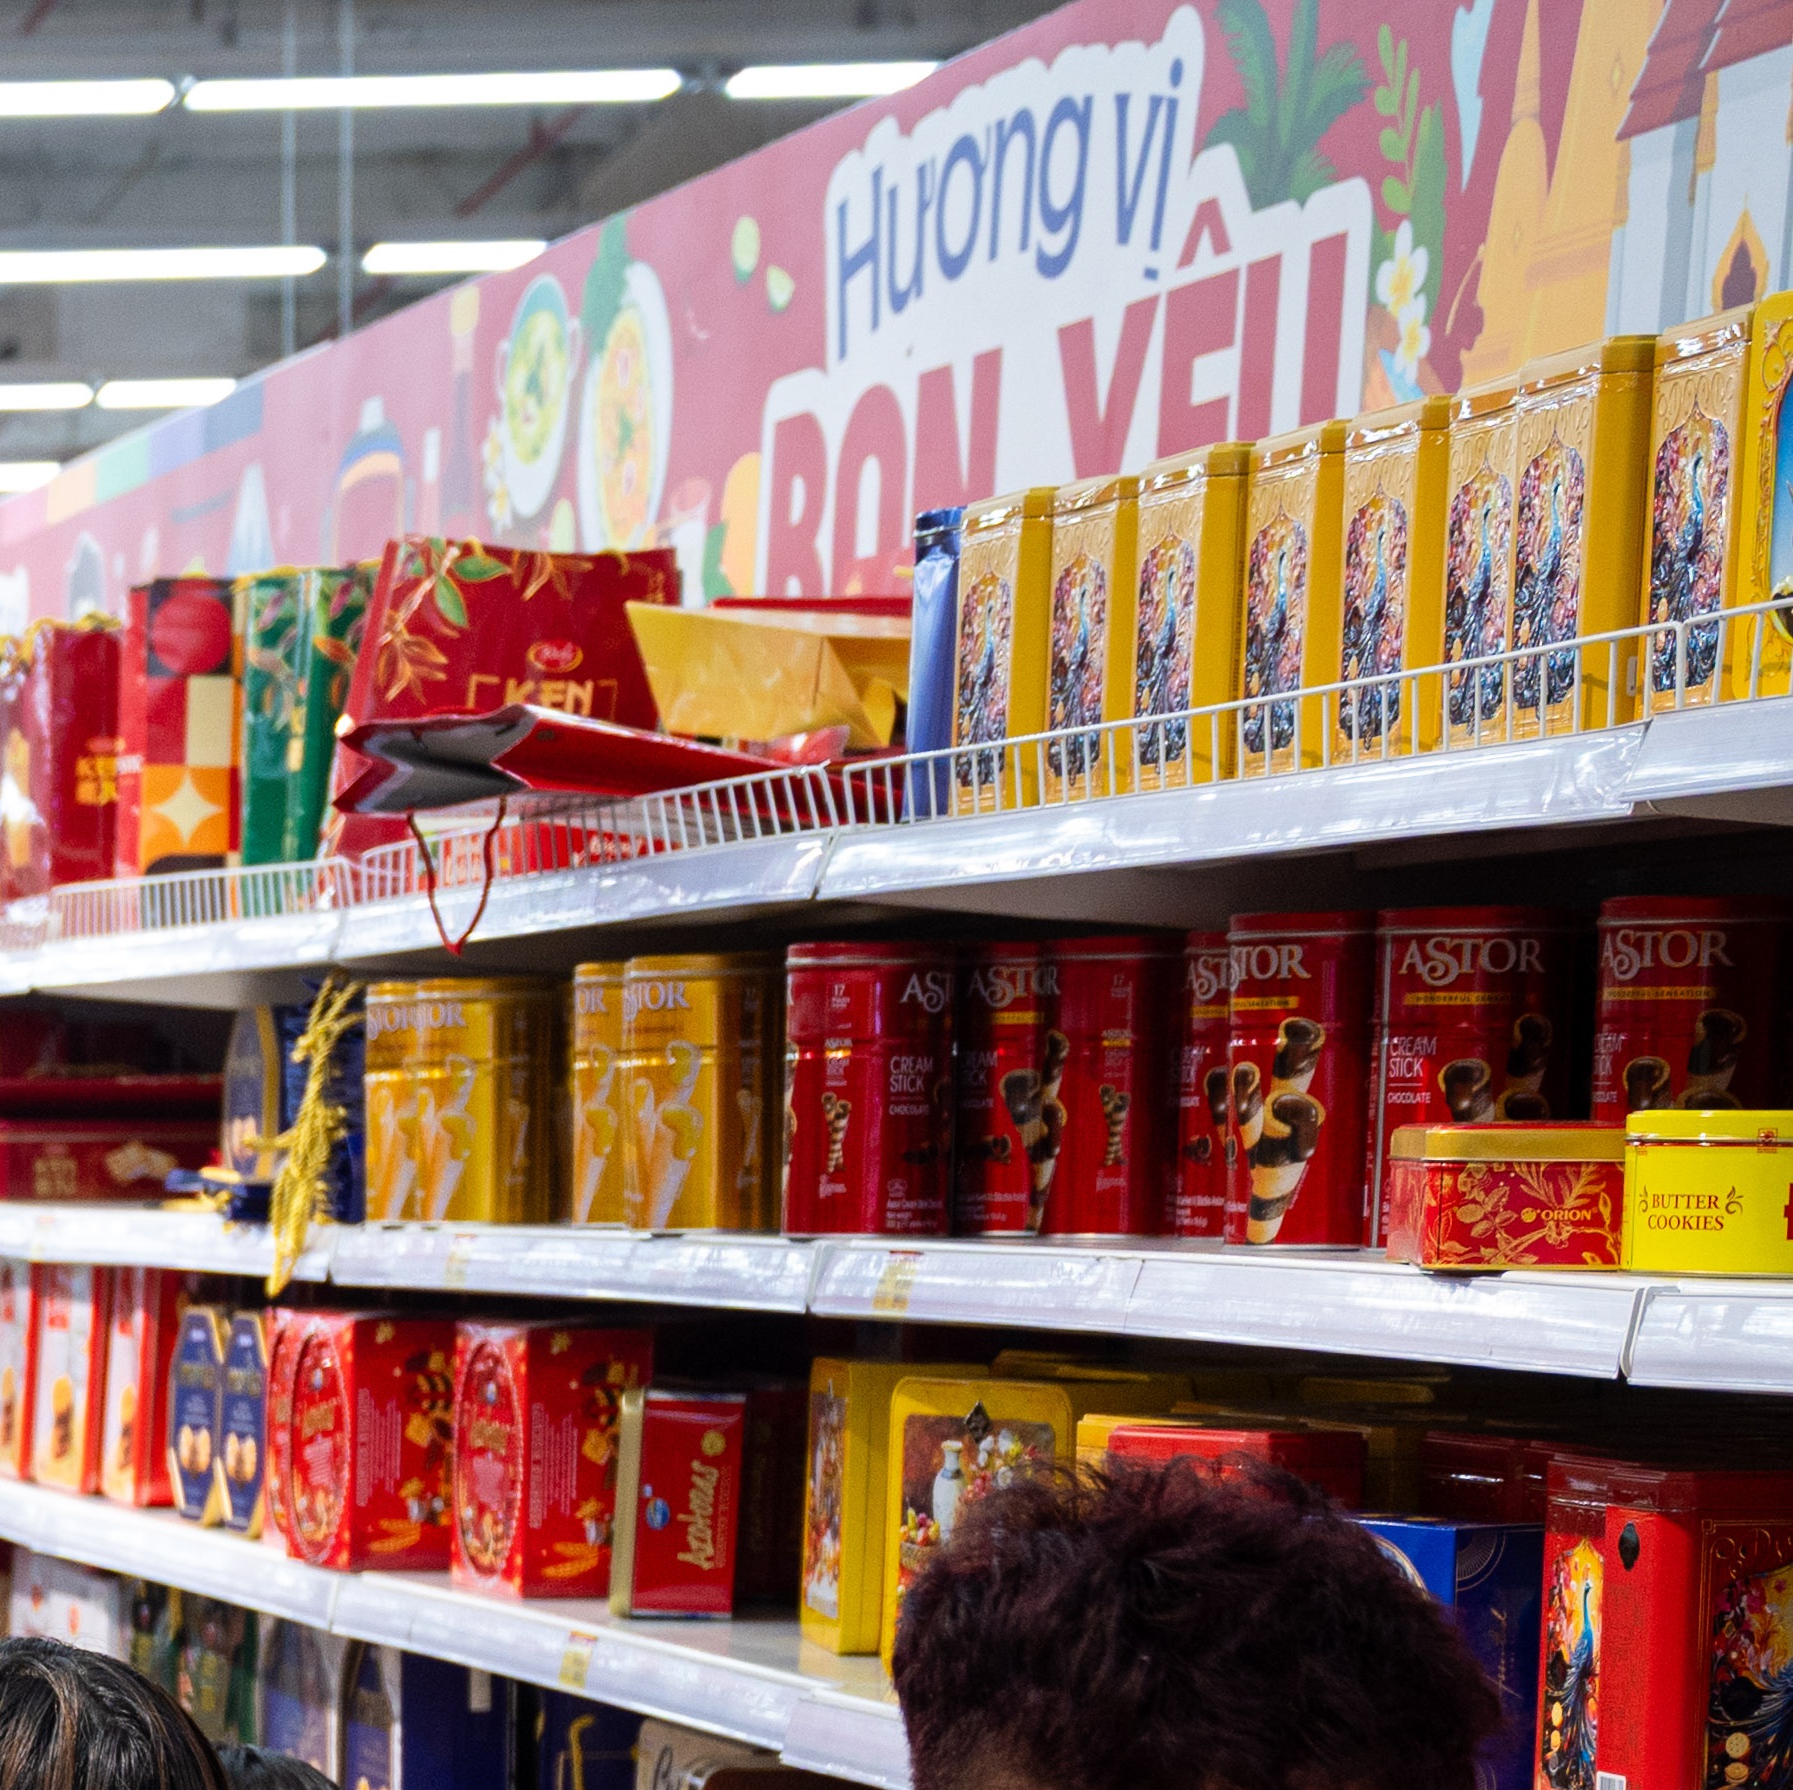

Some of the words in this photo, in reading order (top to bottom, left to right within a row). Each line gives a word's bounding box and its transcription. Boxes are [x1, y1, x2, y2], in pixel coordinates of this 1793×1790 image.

[837, 91, 1094, 361] Hương
[1114, 57, 1186, 280] vị
[1059, 198, 1350, 477] YÊU
[1399, 937, 1544, 986] ASTOR
[1601, 929, 1735, 981] ASTOR
[900, 971, 953, 1013] AST
[1389, 1036, 1437, 1056] CREAM
[890, 1056, 933, 1074] CREAM
[1389, 1058, 1424, 1078] STICK
[890, 1075, 925, 1093] STICK
[1387, 1091, 1431, 1104] CHOCOLATE
[1652, 1194, 1720, 1209] BUTTER
[1542, 1209, 1592, 1221] ORION
[1648, 1216, 1725, 1231] COOKIES
